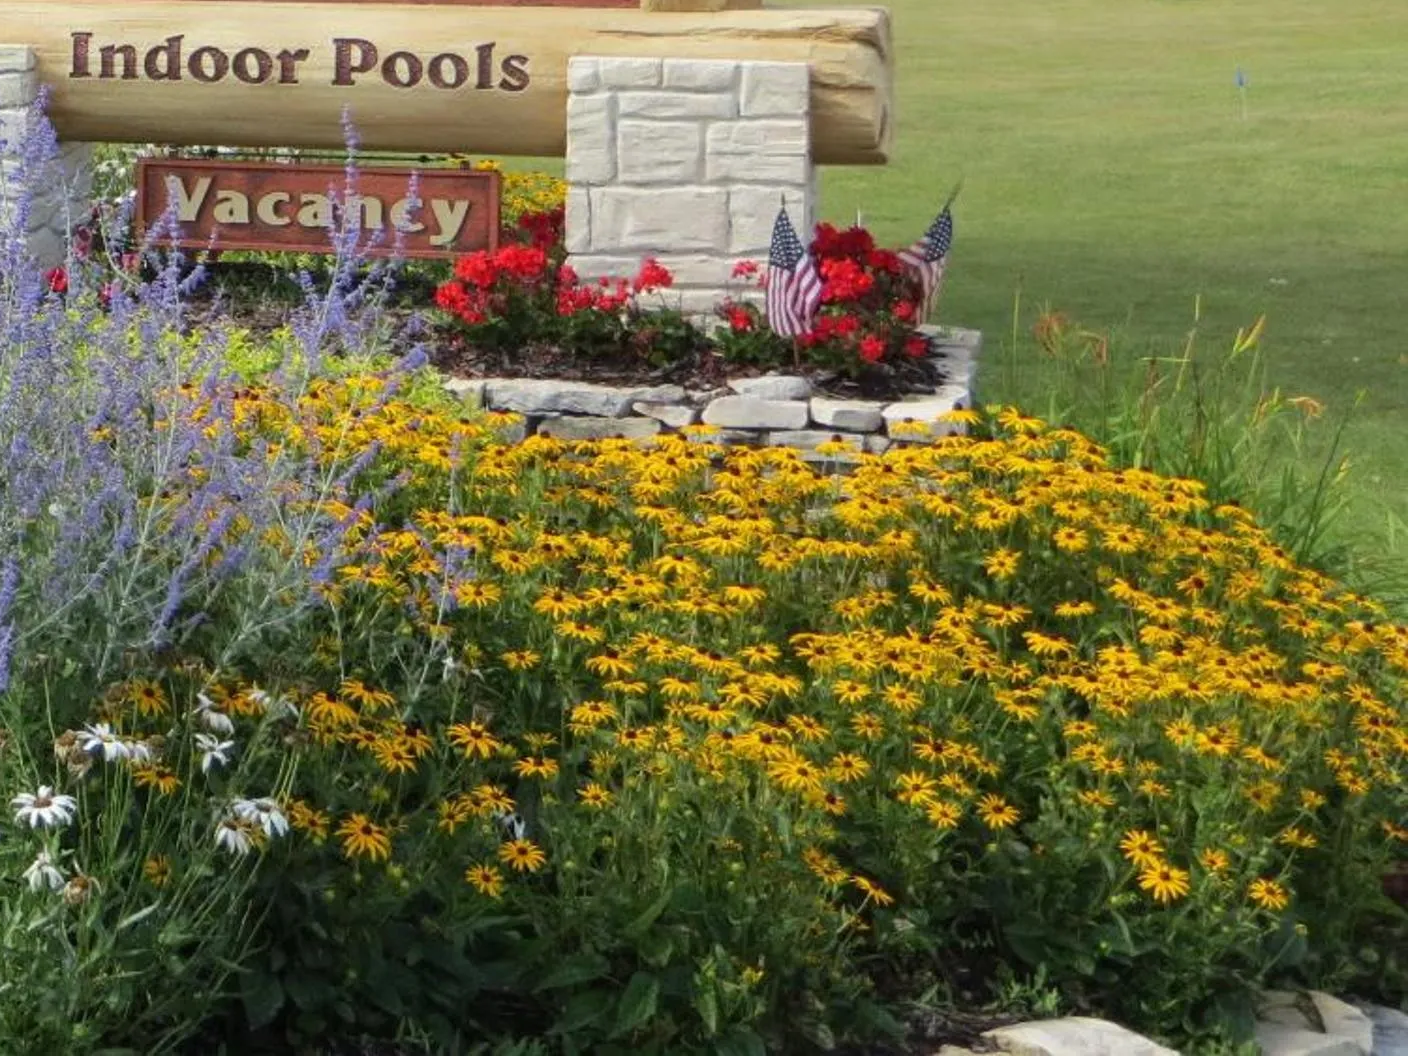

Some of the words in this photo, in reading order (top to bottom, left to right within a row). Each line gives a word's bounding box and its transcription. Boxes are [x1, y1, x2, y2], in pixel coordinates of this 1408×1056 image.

[69, 32, 309, 85] Indoor
[332, 37, 531, 92] Pools
[164, 175, 470, 246] Vacancy
